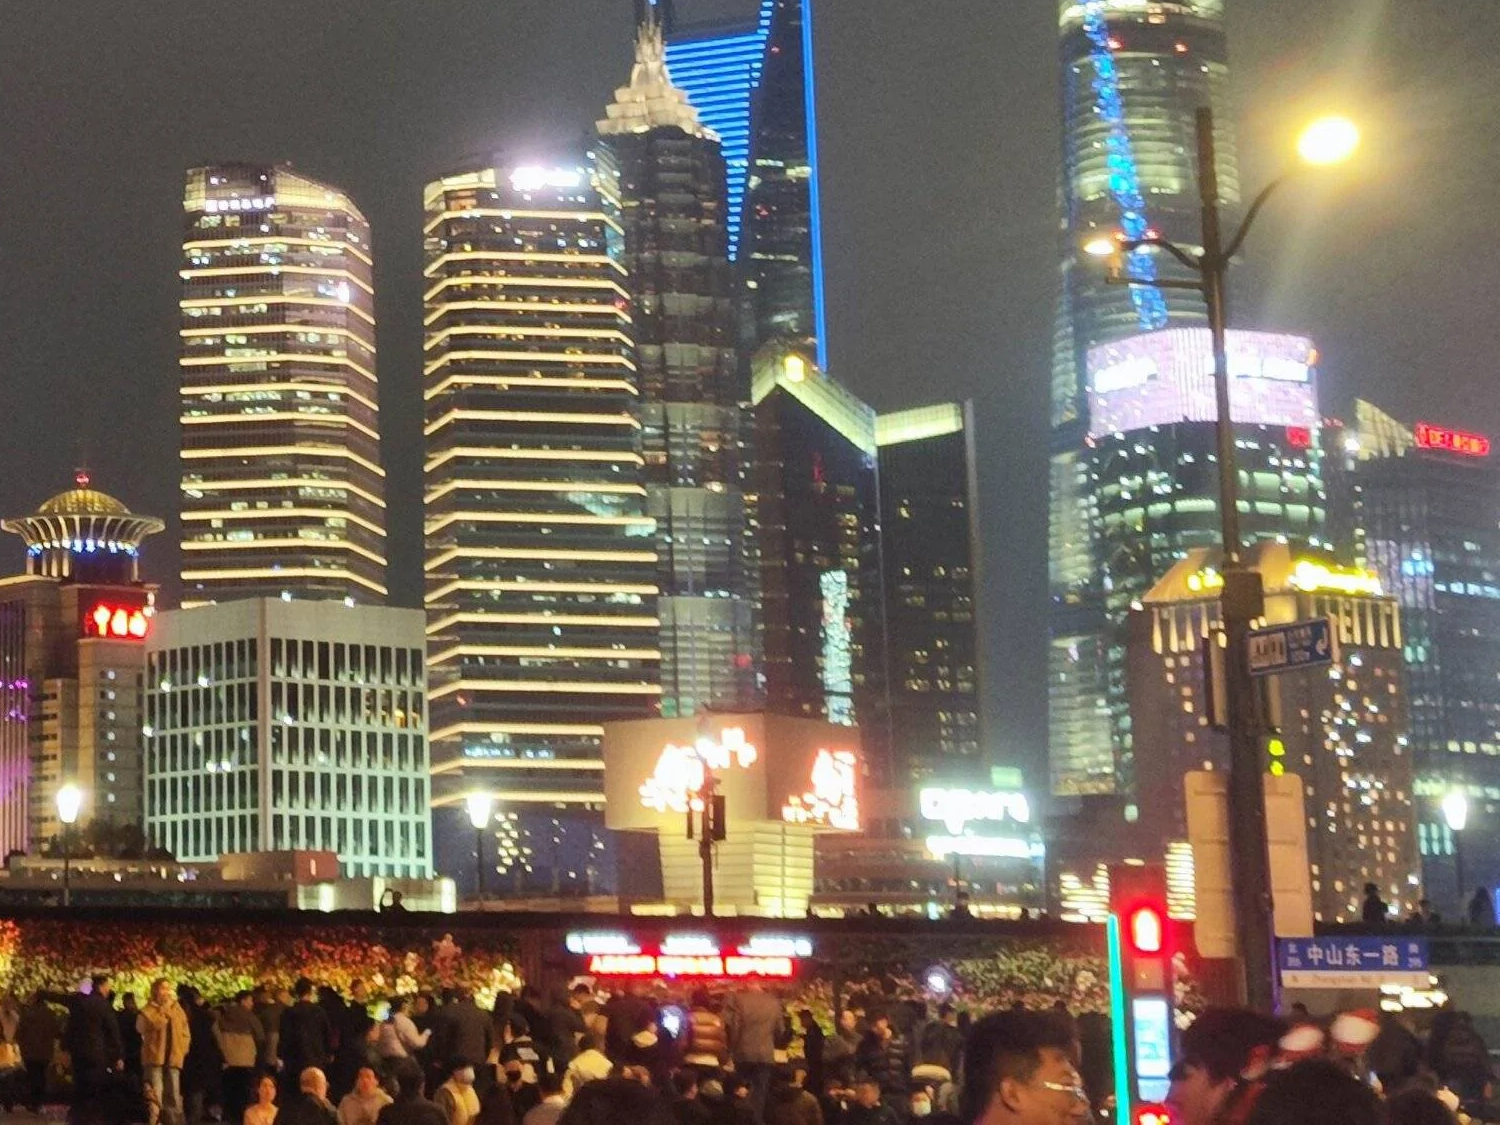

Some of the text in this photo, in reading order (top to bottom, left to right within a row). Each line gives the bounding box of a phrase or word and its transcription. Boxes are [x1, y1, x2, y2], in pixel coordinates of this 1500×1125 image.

[1307, 943, 1399, 966] 中山东一路
